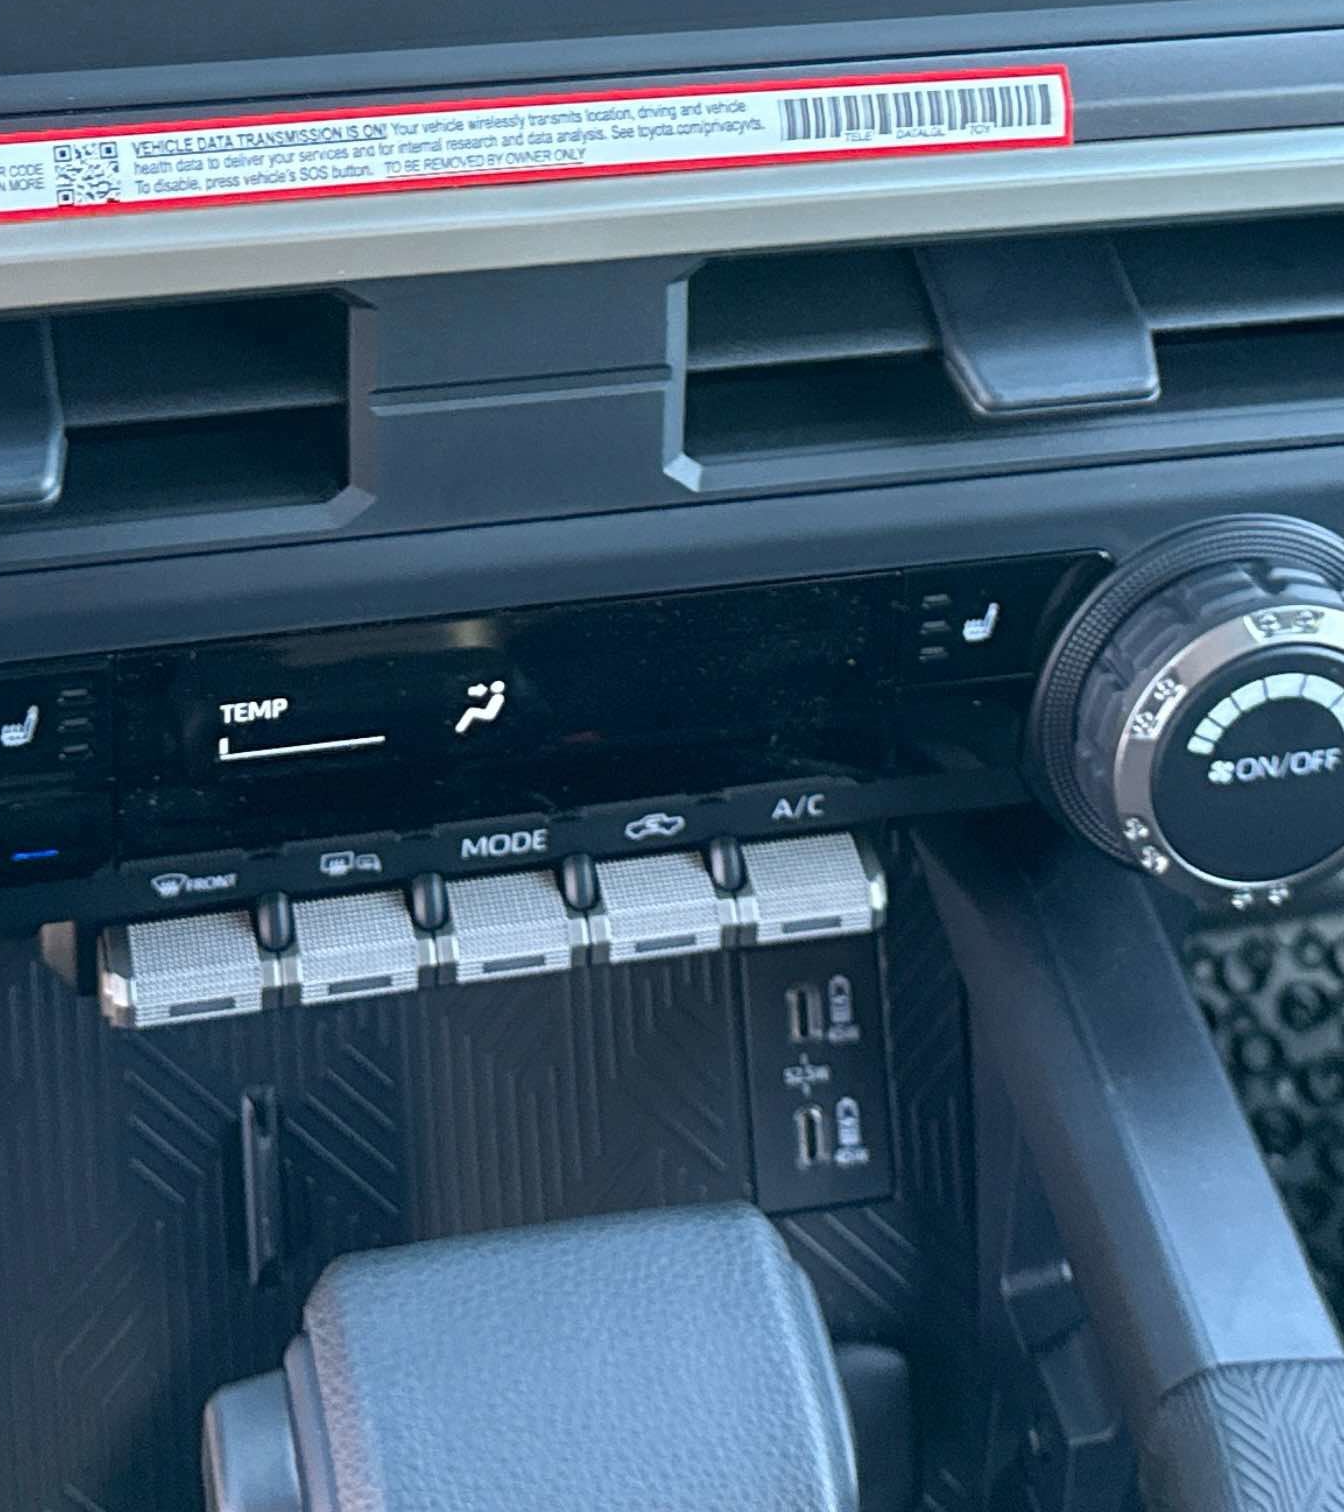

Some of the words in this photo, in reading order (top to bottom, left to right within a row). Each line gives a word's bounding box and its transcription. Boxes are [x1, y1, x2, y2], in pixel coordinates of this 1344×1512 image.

[132, 137, 193, 155] VEHICLE
[197, 134, 233, 150] DATA
[237, 126, 343, 148] TRANSMISSION
[390, 121, 419, 135] Your
[423, 118, 464, 133] vehicle
[468, 115, 525, 131] wirelessly
[528, 110, 582, 127] transmits
[638, 104, 677, 120] driving
[680, 102, 702, 116] and
[706, 99, 746, 114] vehicle
[134, 159, 172, 176] health
[176, 157, 203, 172] data
[208, 157, 220, 170] to
[224, 153, 264, 169] deliver
[269, 152, 296, 168] your
[299, 147, 349, 163] services
[352, 144, 375, 159] and
[379, 142, 395, 156] for
[501, 132, 523, 147] and
[527, 130, 553, 145] data
[611, 124, 635, 139] See
[9, 163, 44, 178] CODE
[9, 176, 45, 191] MORE
[135, 179, 151, 195] To
[206, 175, 240, 191] press
[299, 165, 328, 182] SOS
[384, 160, 402, 174] TO
[405, 158, 421, 172] BE
[424, 154, 484, 171] REMOVED
[505, 148, 552, 164] OWNER
[556, 146, 587, 162] ONLY
[220, 698, 288, 724] TEMP
[1236, 748, 1342, 780] ON/OFF
[771, 793, 825, 820] A/C
[462, 829, 547, 859] MODE
